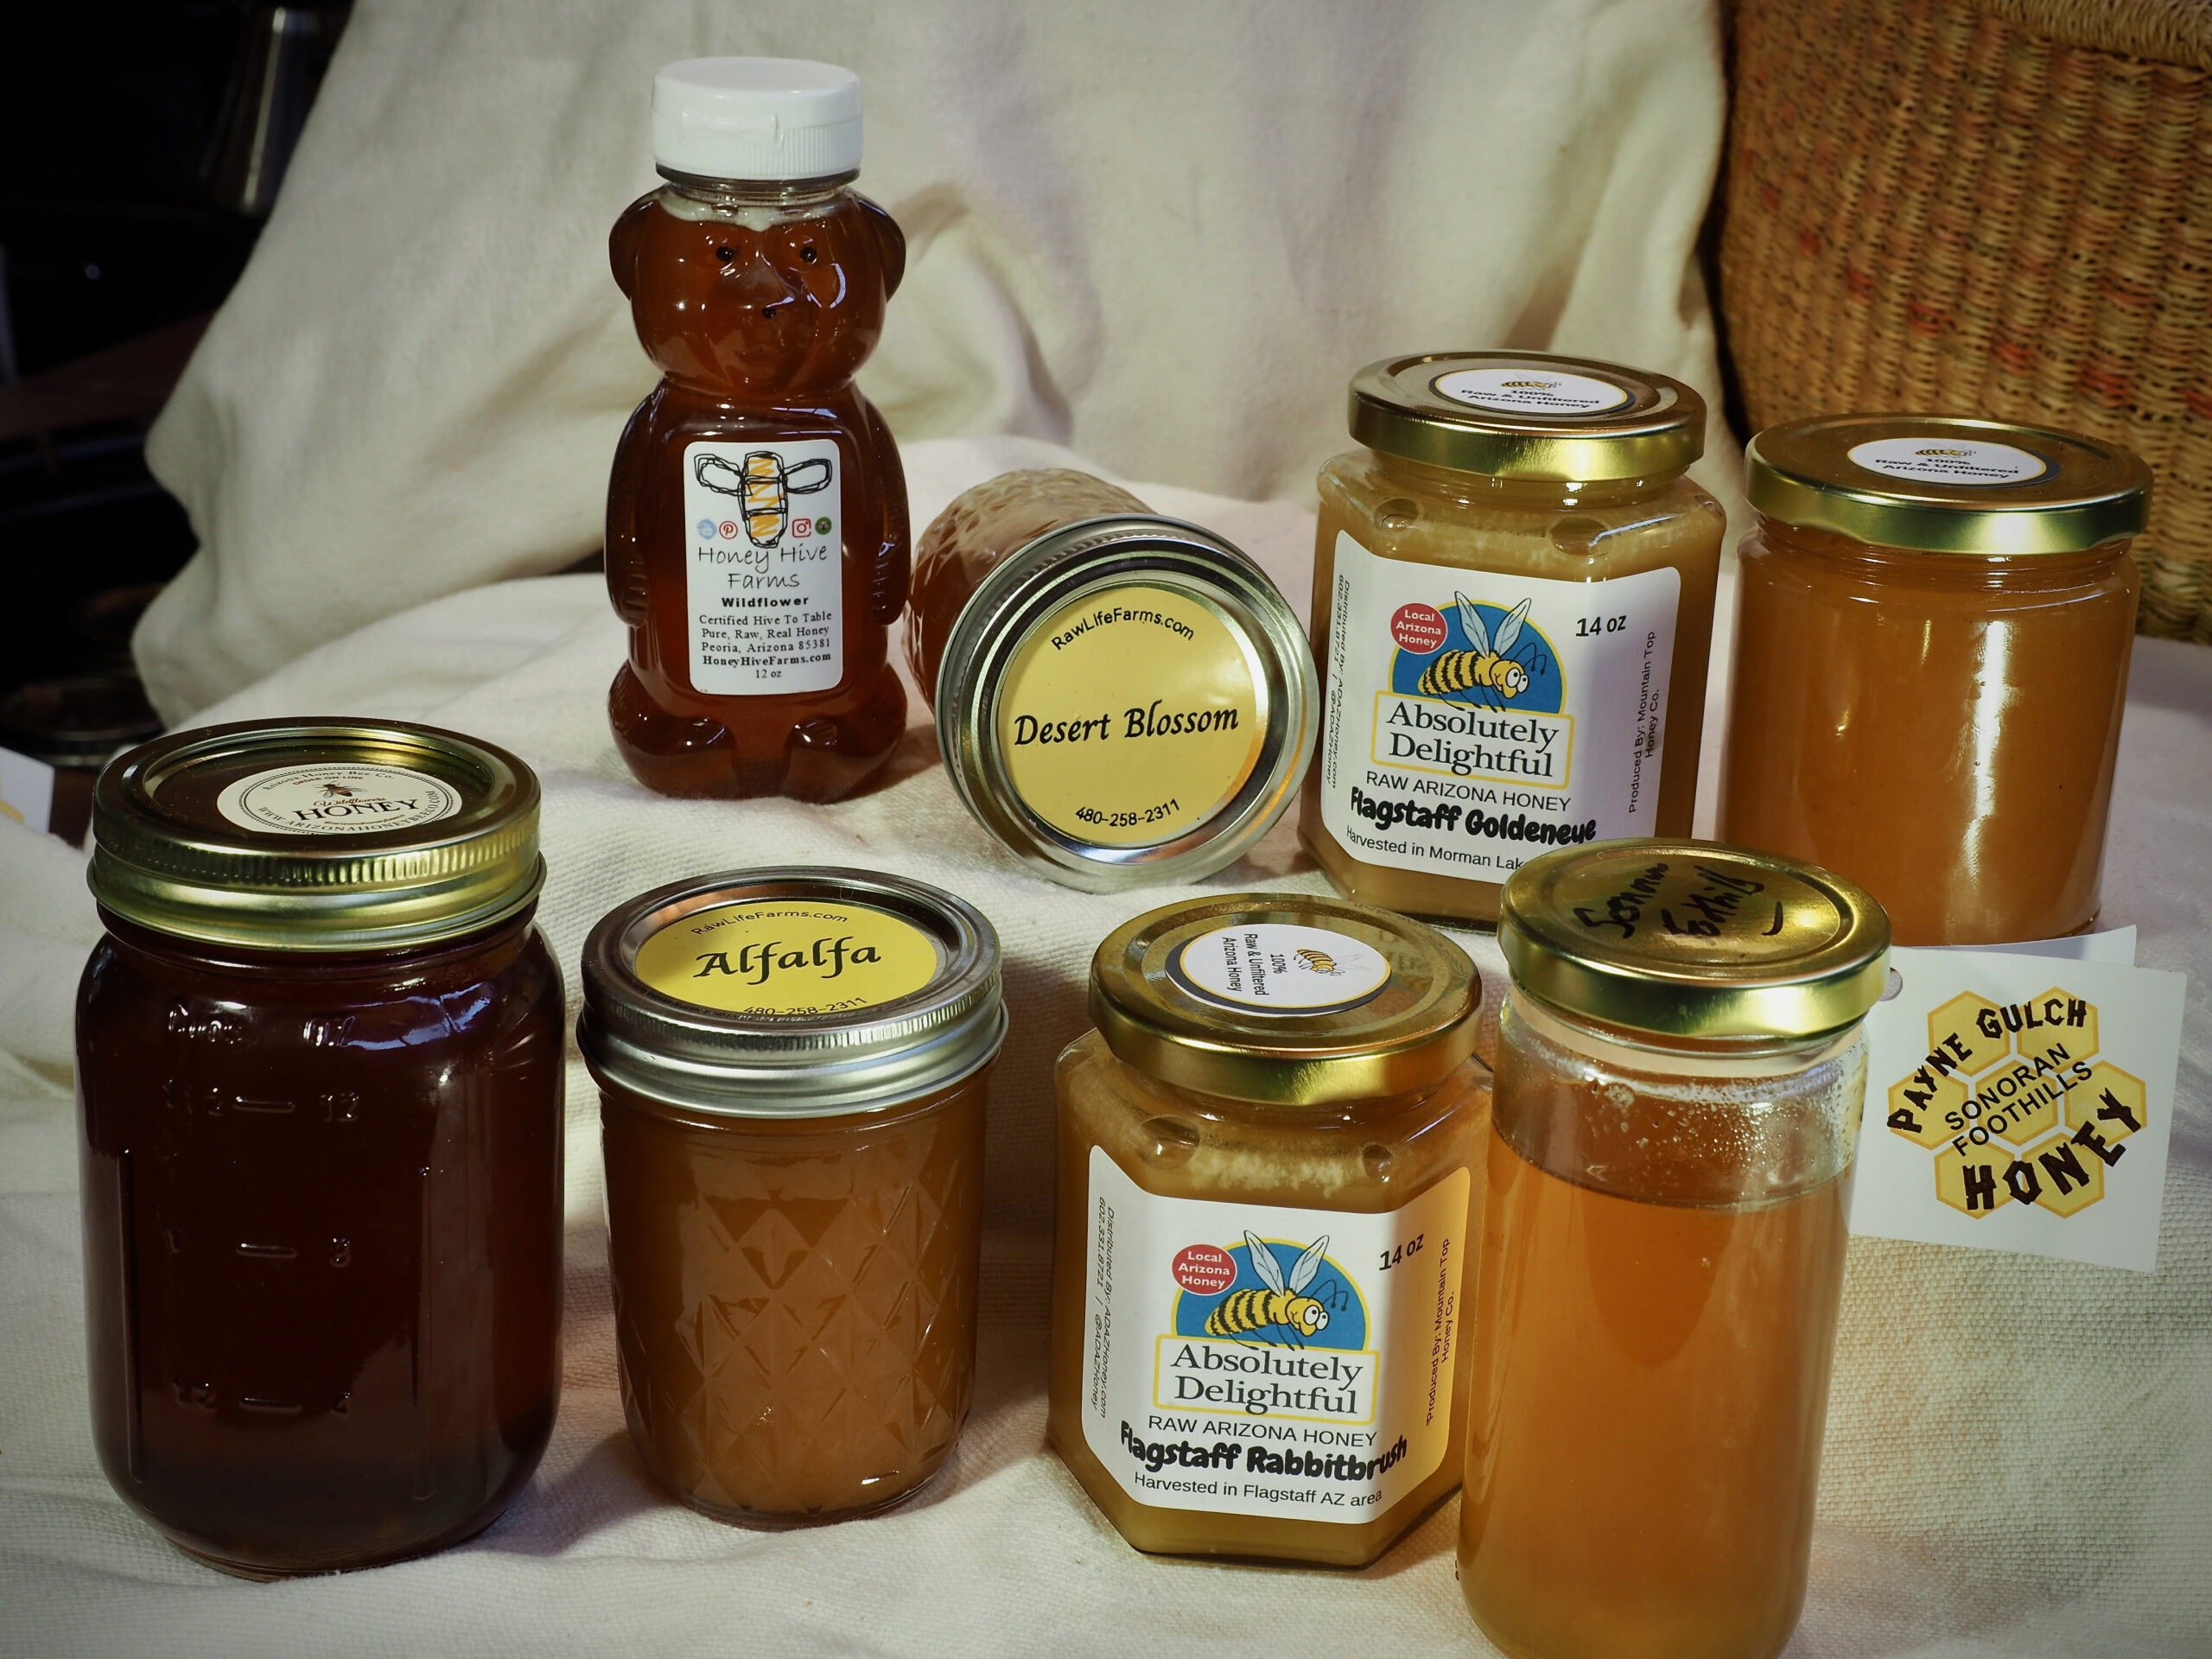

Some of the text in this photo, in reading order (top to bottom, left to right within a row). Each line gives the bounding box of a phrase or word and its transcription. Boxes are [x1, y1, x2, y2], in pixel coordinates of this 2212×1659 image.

[1468, 395, 1533, 404] Arizona
[1519, 394, 1600, 404] Unfiltered
[1883, 465, 2010, 479] Arizona Honey
[1935, 463, 2019, 474] Unfiltered
[698, 543, 828, 574] Honey Hive
[728, 573, 800, 589] Farms
[699, 610, 833, 626] Certified Hive To Table
[721, 596, 810, 607] Wildflower
[1340, 580, 1350, 652] Distributed
[1404, 609, 1435, 622] Local
[702, 626, 830, 640] Pure, Raw, Real Honey
[1395, 620, 1442, 636] Arizona
[1398, 632, 1438, 649] Honey
[1575, 614, 1627, 638] 14 oz
[701, 638, 830, 653] Peoria, Arizona 85381
[702, 652, 831, 668] HoneyHiveFarms.com
[755, 669, 767, 678] 12
[1014, 699, 1239, 746] Desert Blossom
[1386, 701, 1560, 754] Absolutely
[1629, 631, 1656, 814] Produced By: Mountain Top
[1644, 689, 1660, 759] Honey Co.
[1389, 733, 1554, 777] Delightful
[1350, 786, 1463, 831] Flagstaff
[1365, 770, 1572, 812] RAW ARIZONA HONEY
[292, 798, 420, 821] HONEY
[1075, 798, 1181, 827] 480-258-2311
[1345, 824, 1524, 870] Harvested in Morman Lak
[1244, 933, 1258, 950] Raw
[692, 936, 882, 986] Alfalfa
[1222, 937, 1243, 992] Arizona Honey
[1249, 958, 1269, 995] Unfiltered
[1269, 953, 1287, 975] 100%
[743, 997, 868, 1015] 480-258-2311
[1886, 998, 2087, 1134] PAYNE GULCH
[1944, 1042, 2071, 1131] SONORAN
[1951, 1061, 2093, 1158] FOOTHILLS
[1962, 1086, 2142, 1211] HONEY
[1096, 1196, 1106, 1286] 602.331.8721
[1106, 1206, 1115, 1281] Distributed
[1186, 1250, 1222, 1263] Local
[1378, 1233, 1426, 1272] 14 oz
[1177, 1262, 1231, 1276] Arizona
[1181, 1274, 1226, 1290] Honey
[1426, 1238, 1451, 1426] Produced By: Mountain Top
[1441, 1291, 1454, 1363] Honey Co.
[1090, 1313, 1102, 1411] @ADAZHoney
[1101, 1305, 1111, 1419] ADAZHoney.com
[1170, 1343, 1364, 1391] Absolutely
[1173, 1375, 1359, 1414] Delightful
[1148, 1414, 1378, 1447] RAW ARIZONA HONEY
[1121, 1421, 1408, 1482] Flagstaff Rabbitbrush
[1134, 1472, 1383, 1507] Harvested in Flagstaff AZ area
